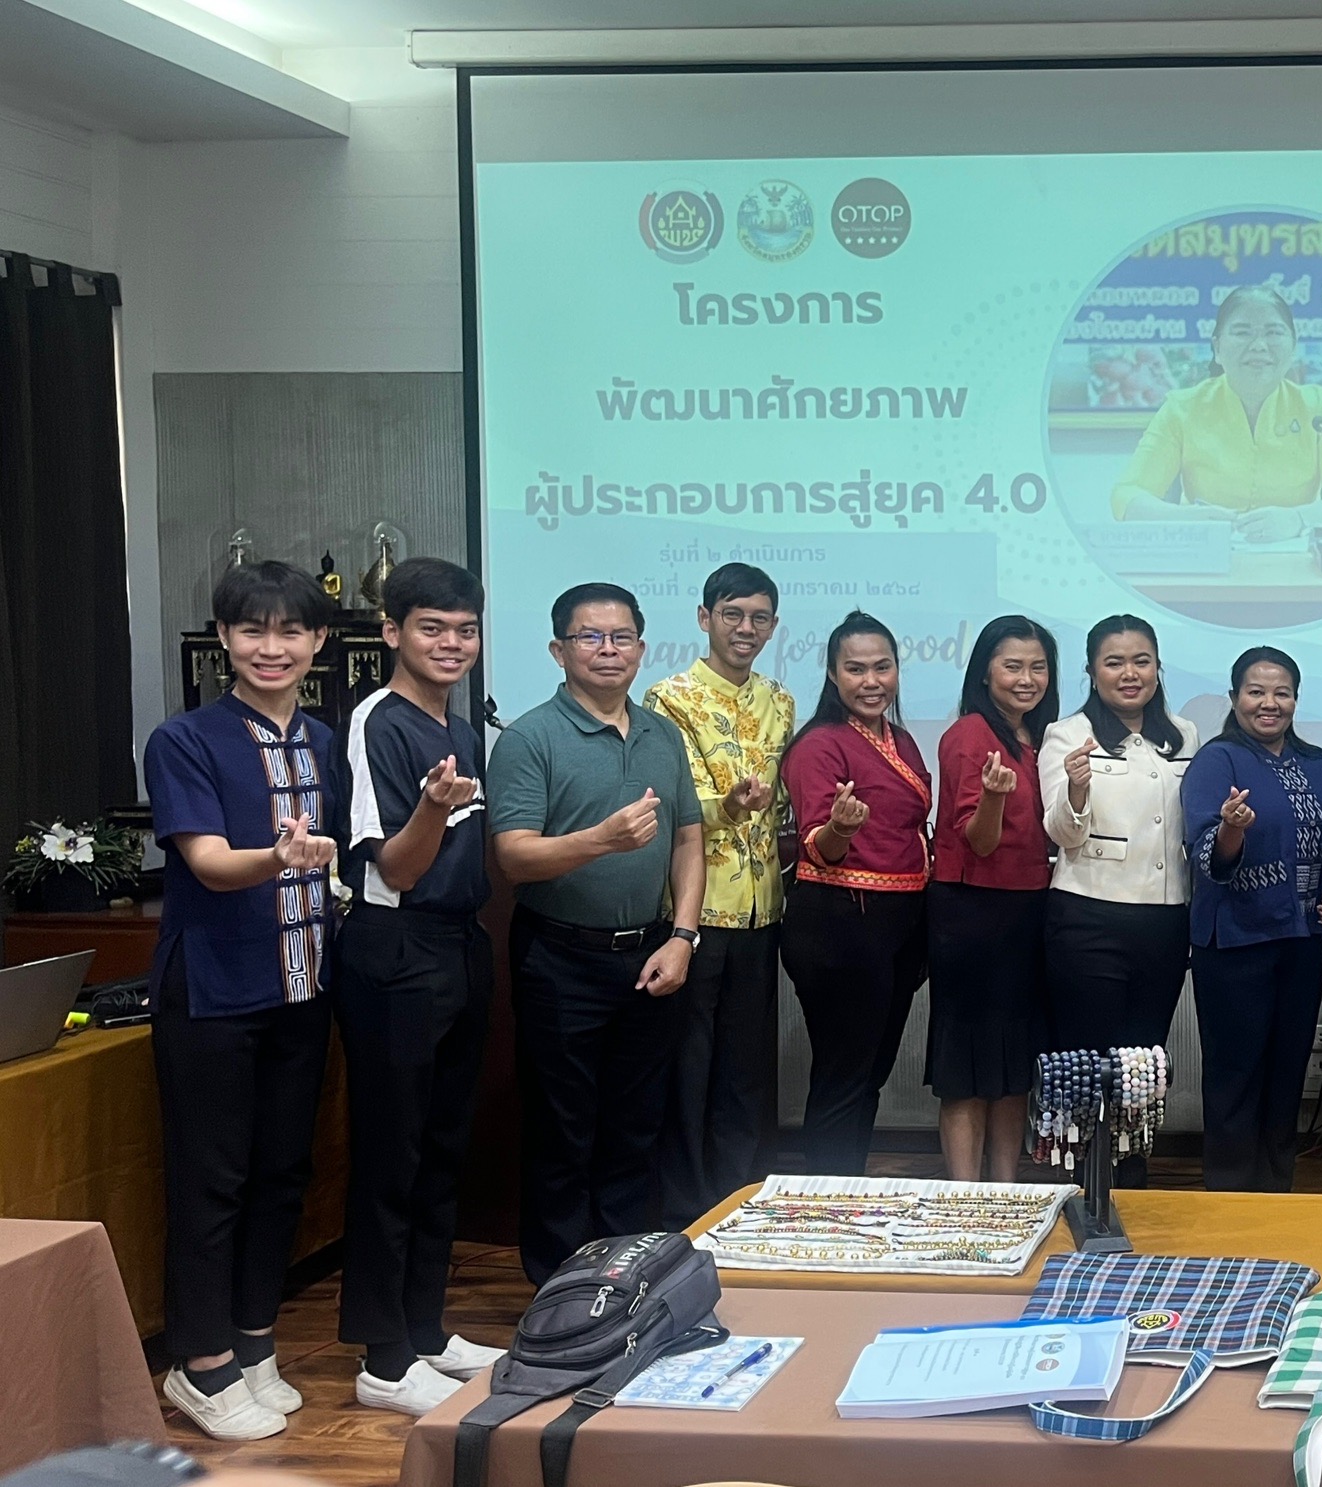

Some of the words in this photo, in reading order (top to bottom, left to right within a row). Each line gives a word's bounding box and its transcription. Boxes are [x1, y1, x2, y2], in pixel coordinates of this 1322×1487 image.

[838, 204, 904, 223] OTOP
[673, 282, 884, 326] โครงการ
[596, 375, 968, 421] พัฒนาศักยภาพ
[525, 469, 945, 531] ผู้ประกอบการสู่ยุค
[965, 472, 1047, 513] 4.0
[660, 538, 699, 568] รุ่นที่
[707, 547, 720, 562] ๒
[729, 543, 826, 562] ดำเนินการ
[866, 580, 921, 596] ๒๕๖๘
[897, 620, 968, 670] ood
